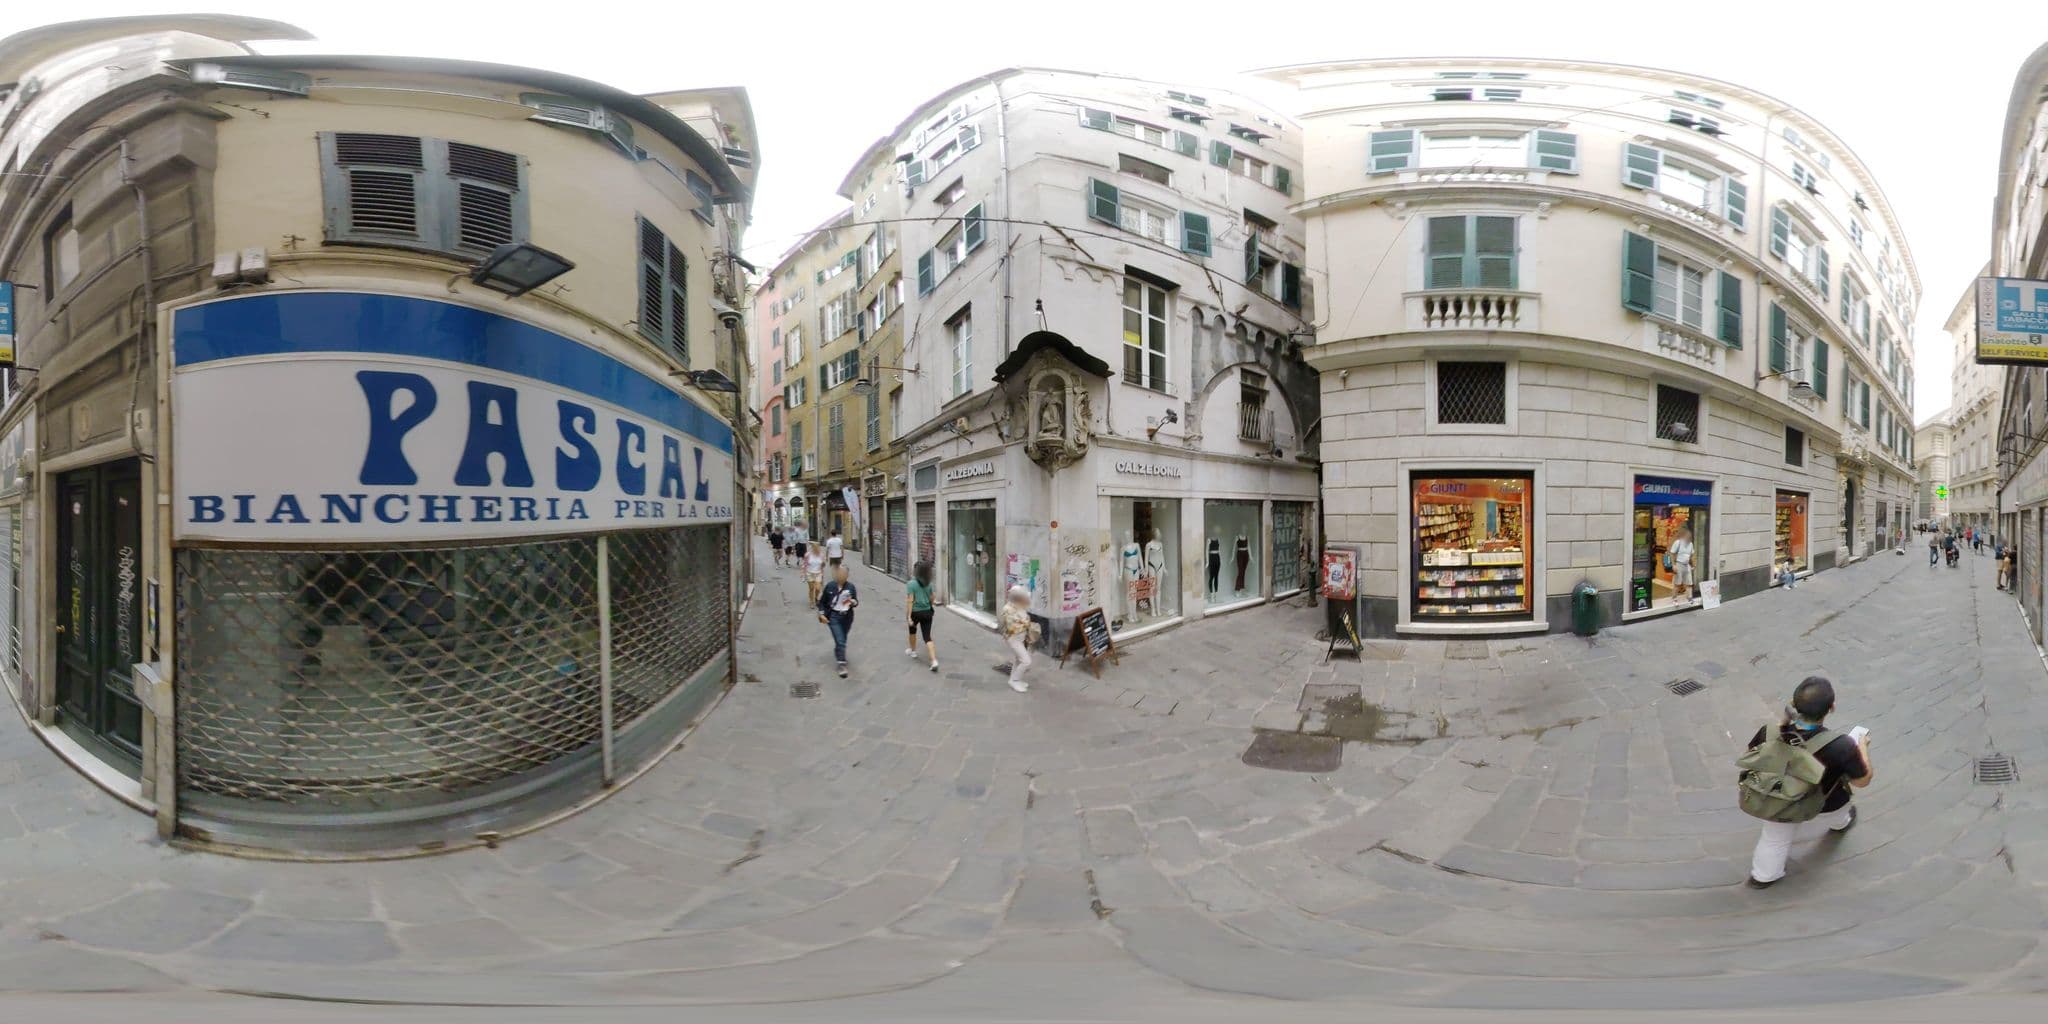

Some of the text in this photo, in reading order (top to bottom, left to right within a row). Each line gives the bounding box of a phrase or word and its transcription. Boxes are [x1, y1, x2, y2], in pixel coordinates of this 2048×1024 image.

[2004, 349, 2041, 358] SERVICE
[356, 370, 709, 503] PASCAL
[946, 461, 995, 482] CALZEDONIA
[1115, 460, 1182, 479] CALZEDONIA
[1430, 482, 1467, 494] GIUNTI
[1642, 483, 1671, 495] GIUNTI
[188, 494, 733, 525] BIANCHERIA PER LA CASA
